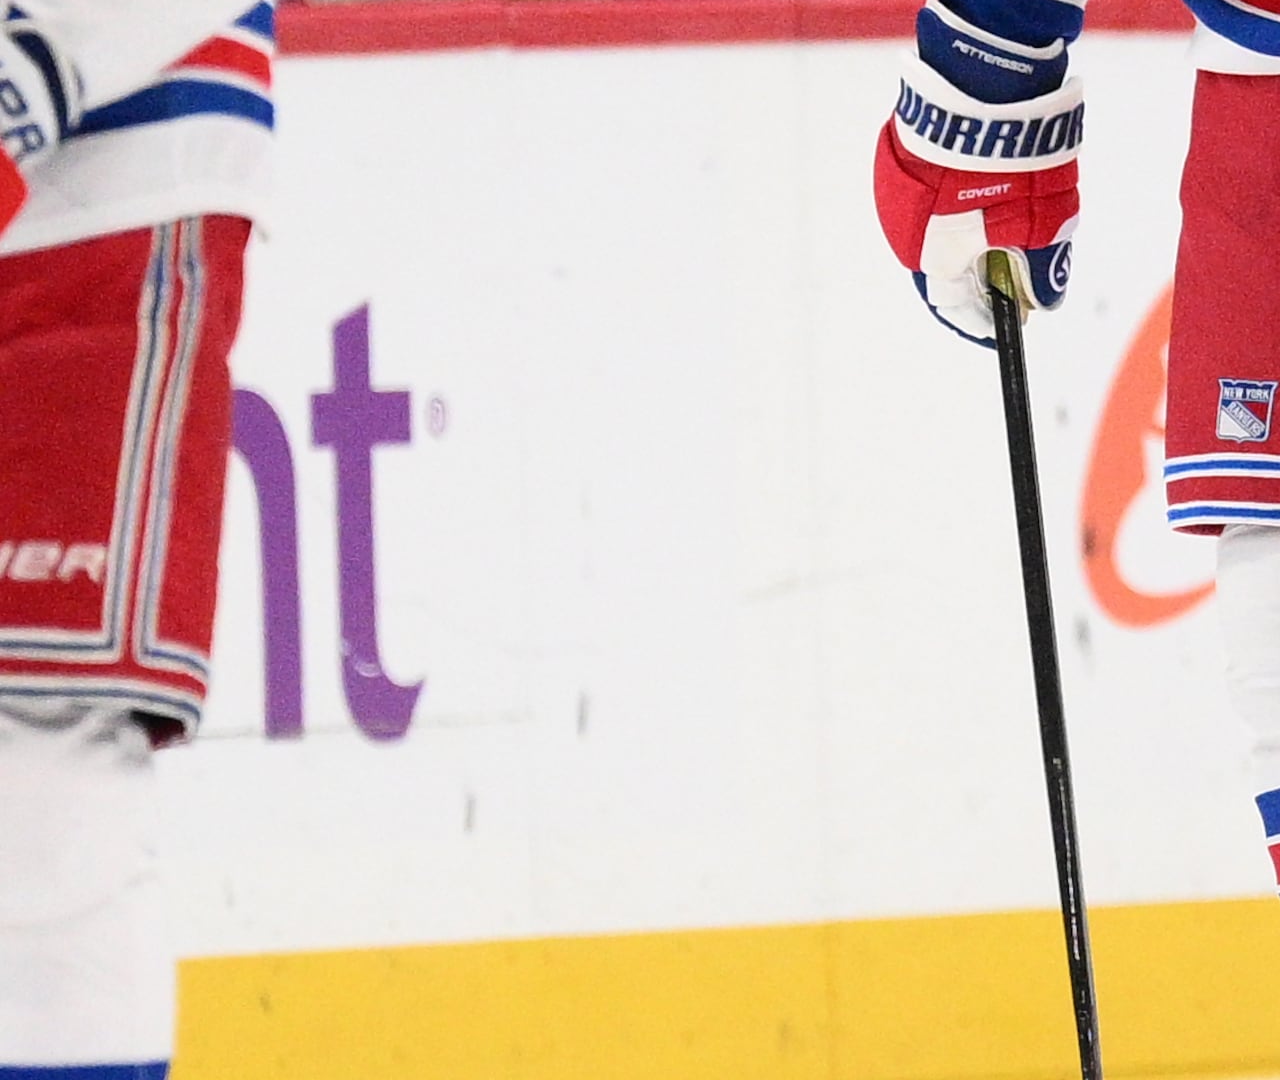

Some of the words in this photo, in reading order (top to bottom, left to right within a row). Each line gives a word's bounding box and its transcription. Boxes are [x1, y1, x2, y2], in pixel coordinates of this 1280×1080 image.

[952, 39, 1034, 76] PETTERSSON
[896, 76, 1085, 159] WARRIOR
[957, 183, 1011, 201] COVERT
